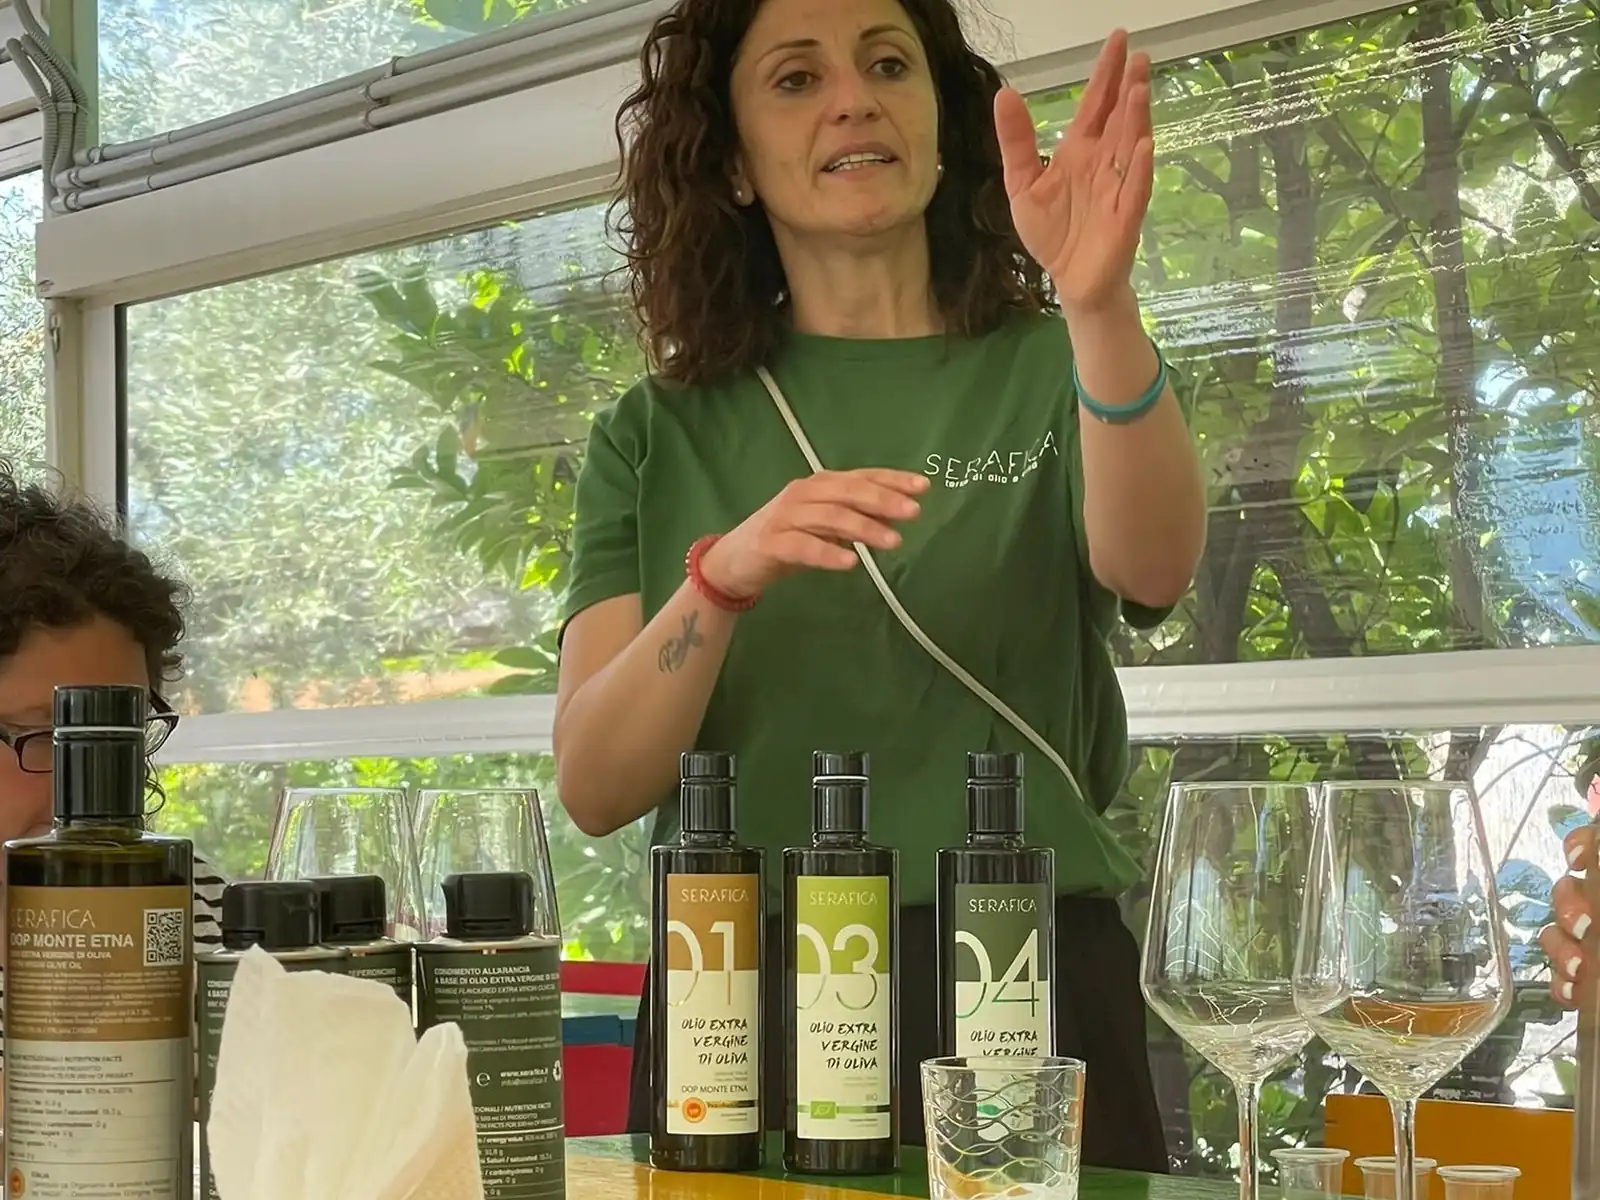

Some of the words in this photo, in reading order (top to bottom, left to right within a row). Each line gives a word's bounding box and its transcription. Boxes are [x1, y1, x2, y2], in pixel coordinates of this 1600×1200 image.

[681, 888, 748, 902] SERAFICA
[809, 891, 878, 906] SERAFICA
[969, 899, 1037, 913] SERAFICA
[33, 934, 86, 948] MONTE
[91, 934, 134, 947] ETNA
[469, 976, 488, 984] OLIO
[490, 975, 516, 983] EXTRA
[681, 1018, 706, 1029] OLIO
[709, 1018, 748, 1031] EXTRA
[809, 1021, 834, 1033] OLIO
[838, 1022, 878, 1035] EXTRA
[693, 1035, 748, 1048] VERGINE
[970, 1030, 995, 1042] OLIO
[1000, 1030, 1038, 1042] EXTRA
[821, 1039, 878, 1053] VERGINE
[698, 1052, 712, 1065] DI
[715, 1052, 748, 1065] OLIVA
[826, 1057, 841, 1069] DI
[844, 1056, 878, 1069] OLIVA
[682, 1085, 698, 1093] DOP
[700, 1085, 728, 1093] MONTE
